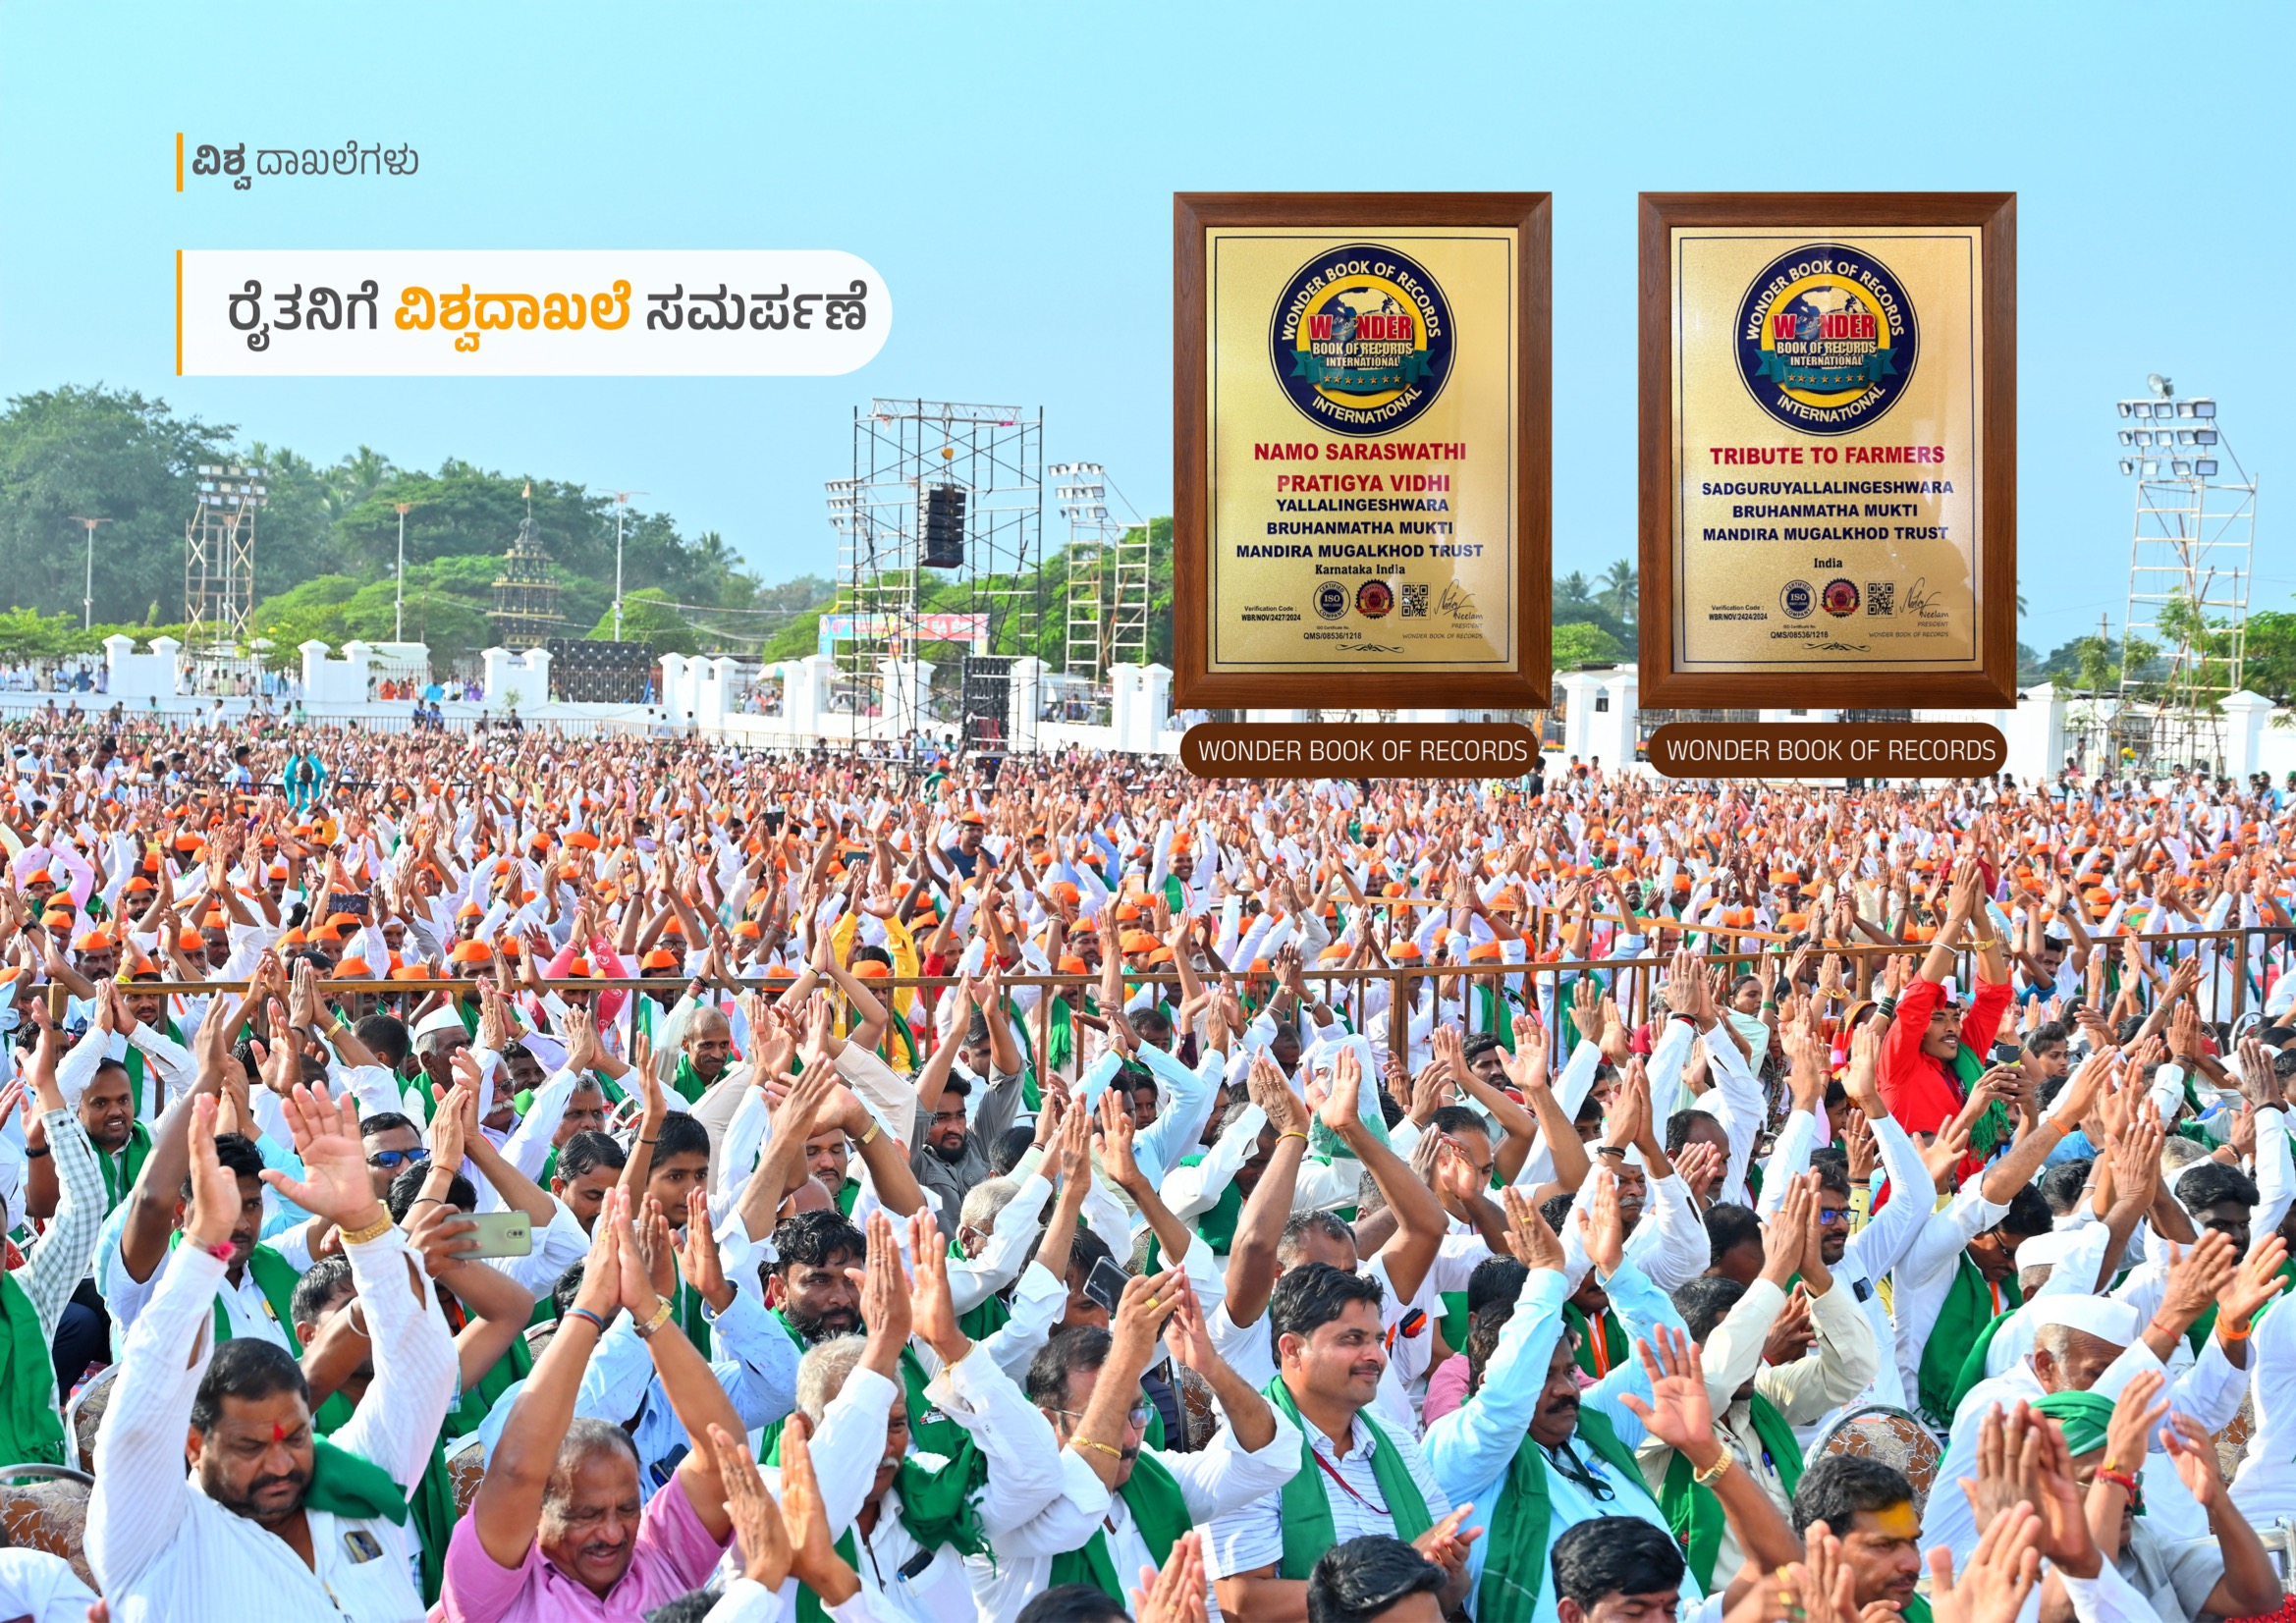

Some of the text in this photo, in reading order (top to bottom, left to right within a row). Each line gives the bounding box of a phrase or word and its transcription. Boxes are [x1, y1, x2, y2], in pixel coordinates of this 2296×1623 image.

[1282, 259, 1442, 342] WONDER BOOK OF RECORDS
[1745, 259, 1905, 342] WONDER BOOK OF RECORDS
[1312, 342, 1414, 355] BOOK OF RECORDS
[1777, 341, 1877, 354] BOOK OF RECORDS
[1325, 355, 1400, 368] INTERNATIONAL
[1789, 354, 1864, 367] INTERNATIONAL
[1311, 386, 1423, 425] INTERNATIONAL
[1777, 385, 1886, 423] INTERNATIONAL
[1254, 442, 1466, 460] NAMO SARASWATHI
[1709, 445, 1945, 465] TRIBUTE TO FARMERS
[1277, 474, 1450, 493] PRATIGYA VIDHI
[1702, 480, 1954, 496] SADGURUYALLALINGESHWARA
[1276, 498, 1449, 513] YALLALINGESHWARA
[1732, 504, 1918, 518] BRUHANMATHA MUKTI
[1267, 521, 1453, 535] BRUHANMATHA MUKTI
[1703, 526, 1949, 541] MANDIRA MUGALKHOD TRUST
[1236, 544, 1484, 559] MANDIRA MUGALKHOD TRUST
[1315, 564, 1405, 575] Karnataka India
[1814, 557, 1843, 568] India
[1319, 582, 1344, 593] CERTIFIED
[1785, 581, 1811, 592] CERTIFIED
[1324, 594, 1340, 603] ISO
[1319, 609, 1344, 620] COMPANY
[1785, 608, 1811, 619] COMPANY
[1303, 631, 1362, 640] QMS/08536/1218
